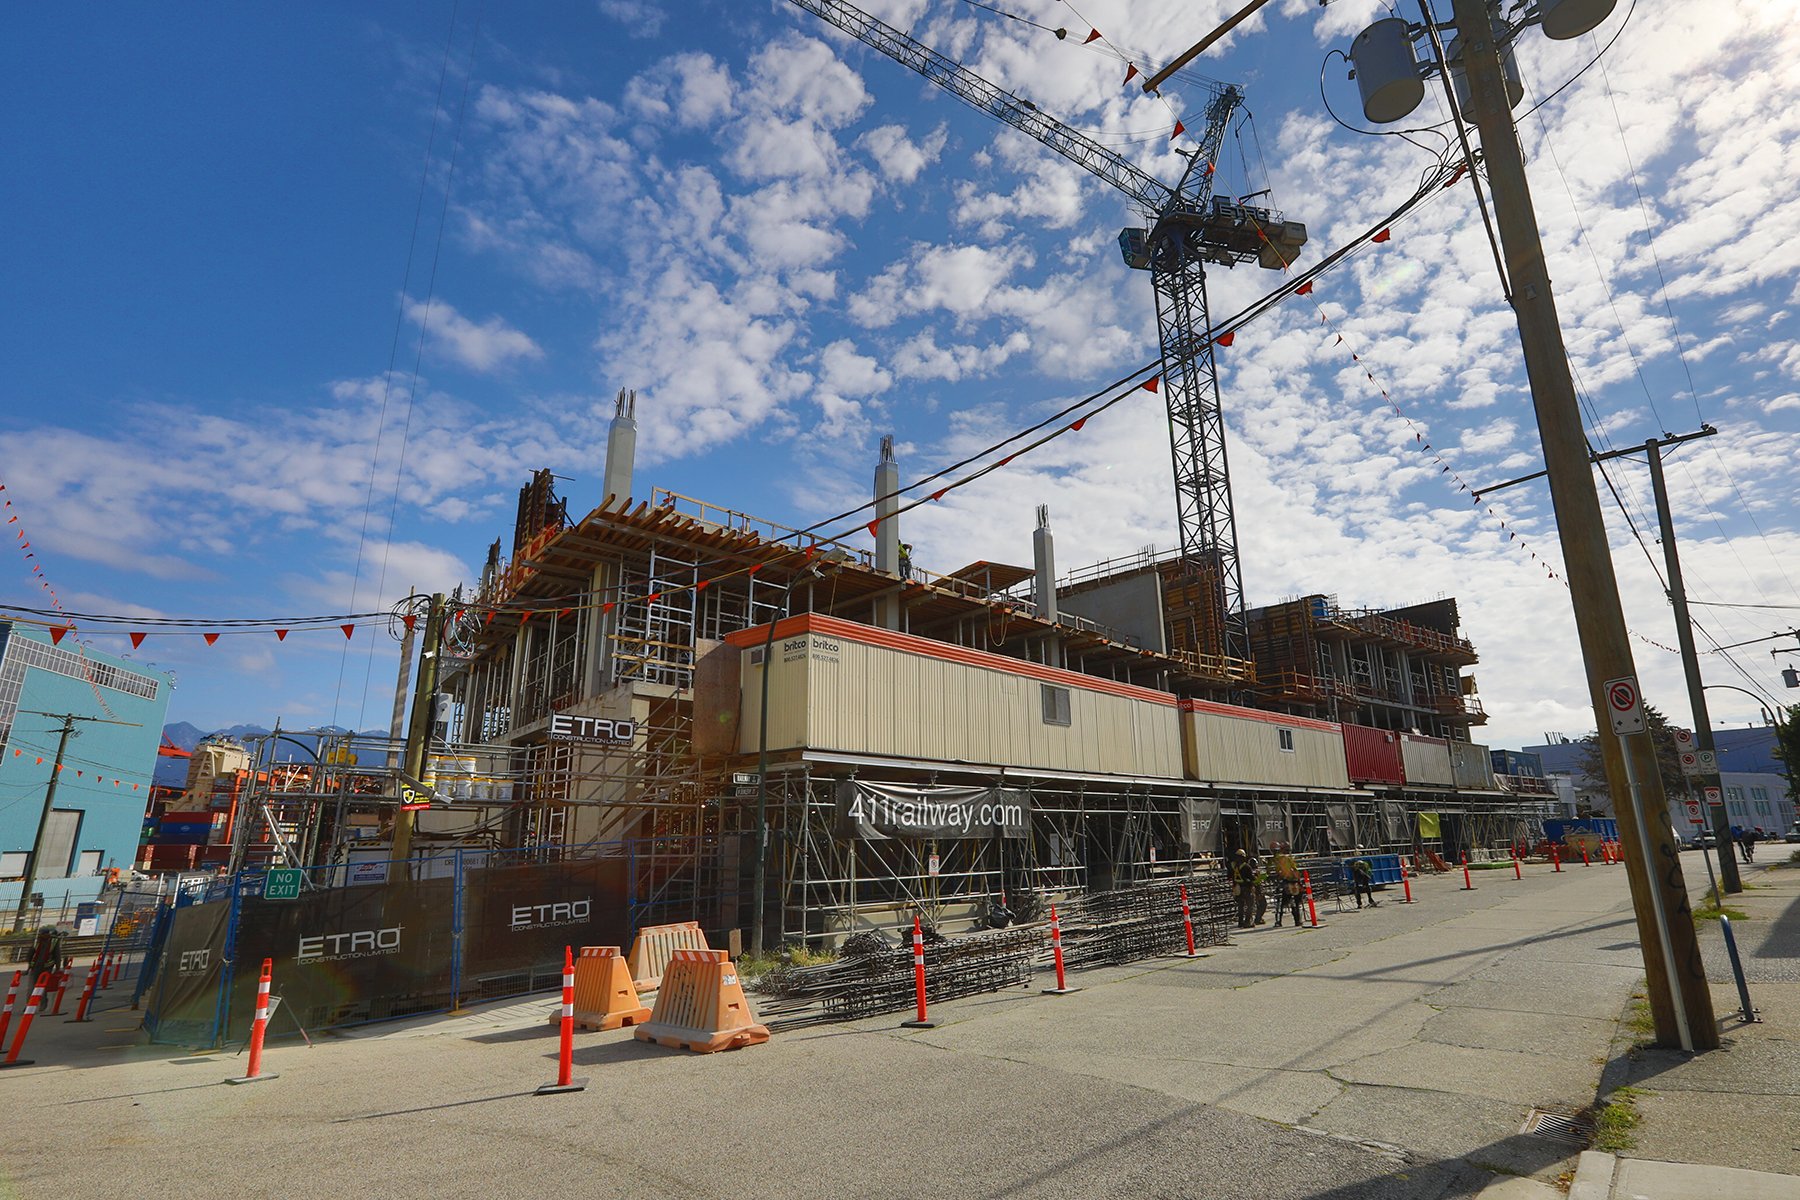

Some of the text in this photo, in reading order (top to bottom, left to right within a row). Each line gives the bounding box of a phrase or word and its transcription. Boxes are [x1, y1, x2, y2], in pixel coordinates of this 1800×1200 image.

[784, 640, 807, 652] britco
[812, 638, 839, 652] britco
[549, 713, 636, 740] ETRO
[552, 733, 631, 746] CONSTRUCTION LIMITED
[848, 792, 1022, 834] 411railway.com
[1192, 820, 1211, 830] ETRO
[1265, 820, 1285, 830] ETRO
[275, 873, 293, 883] NO
[269, 885, 296, 895] EXIT
[511, 899, 590, 926] ETRO
[513, 917, 587, 932] CONSTRUCTION LIMITED
[298, 927, 401, 959] ETRO
[180, 949, 209, 971] ETRO
[300, 947, 397, 965] CONSTRUCTION LIMITED
